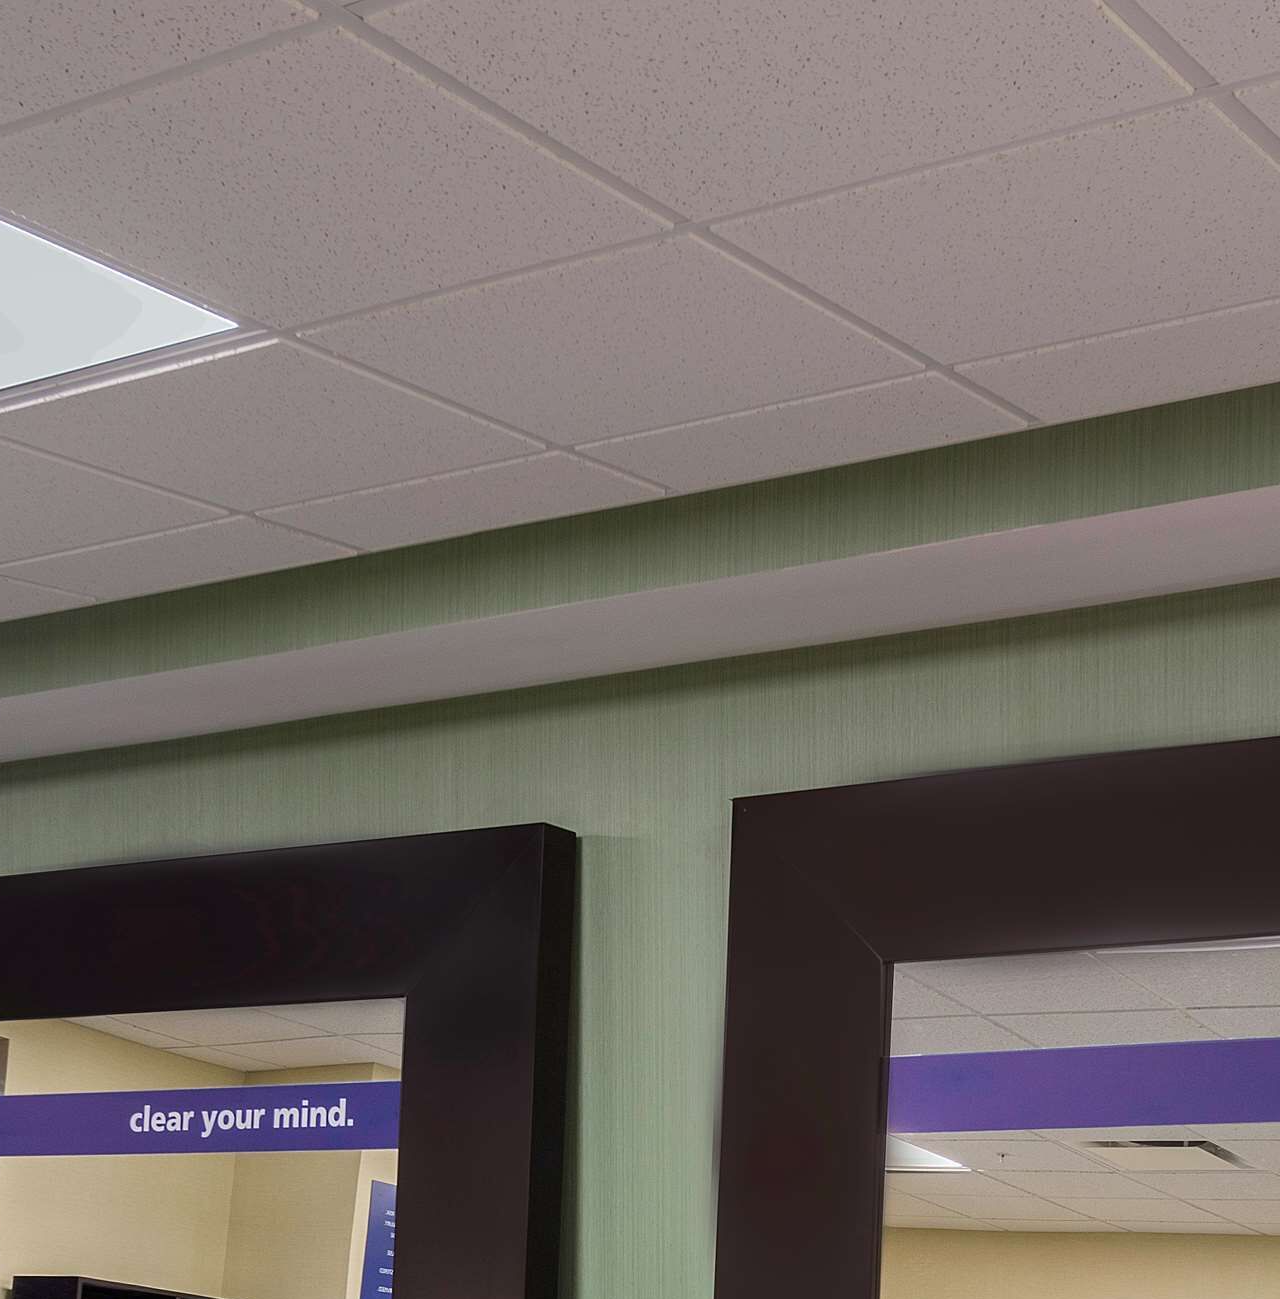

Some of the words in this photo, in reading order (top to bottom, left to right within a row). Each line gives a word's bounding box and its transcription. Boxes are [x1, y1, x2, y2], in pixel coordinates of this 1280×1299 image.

[129, 1104, 195, 1133] clear
[200, 1107, 266, 1138] your
[273, 1097, 355, 1129] mind.
